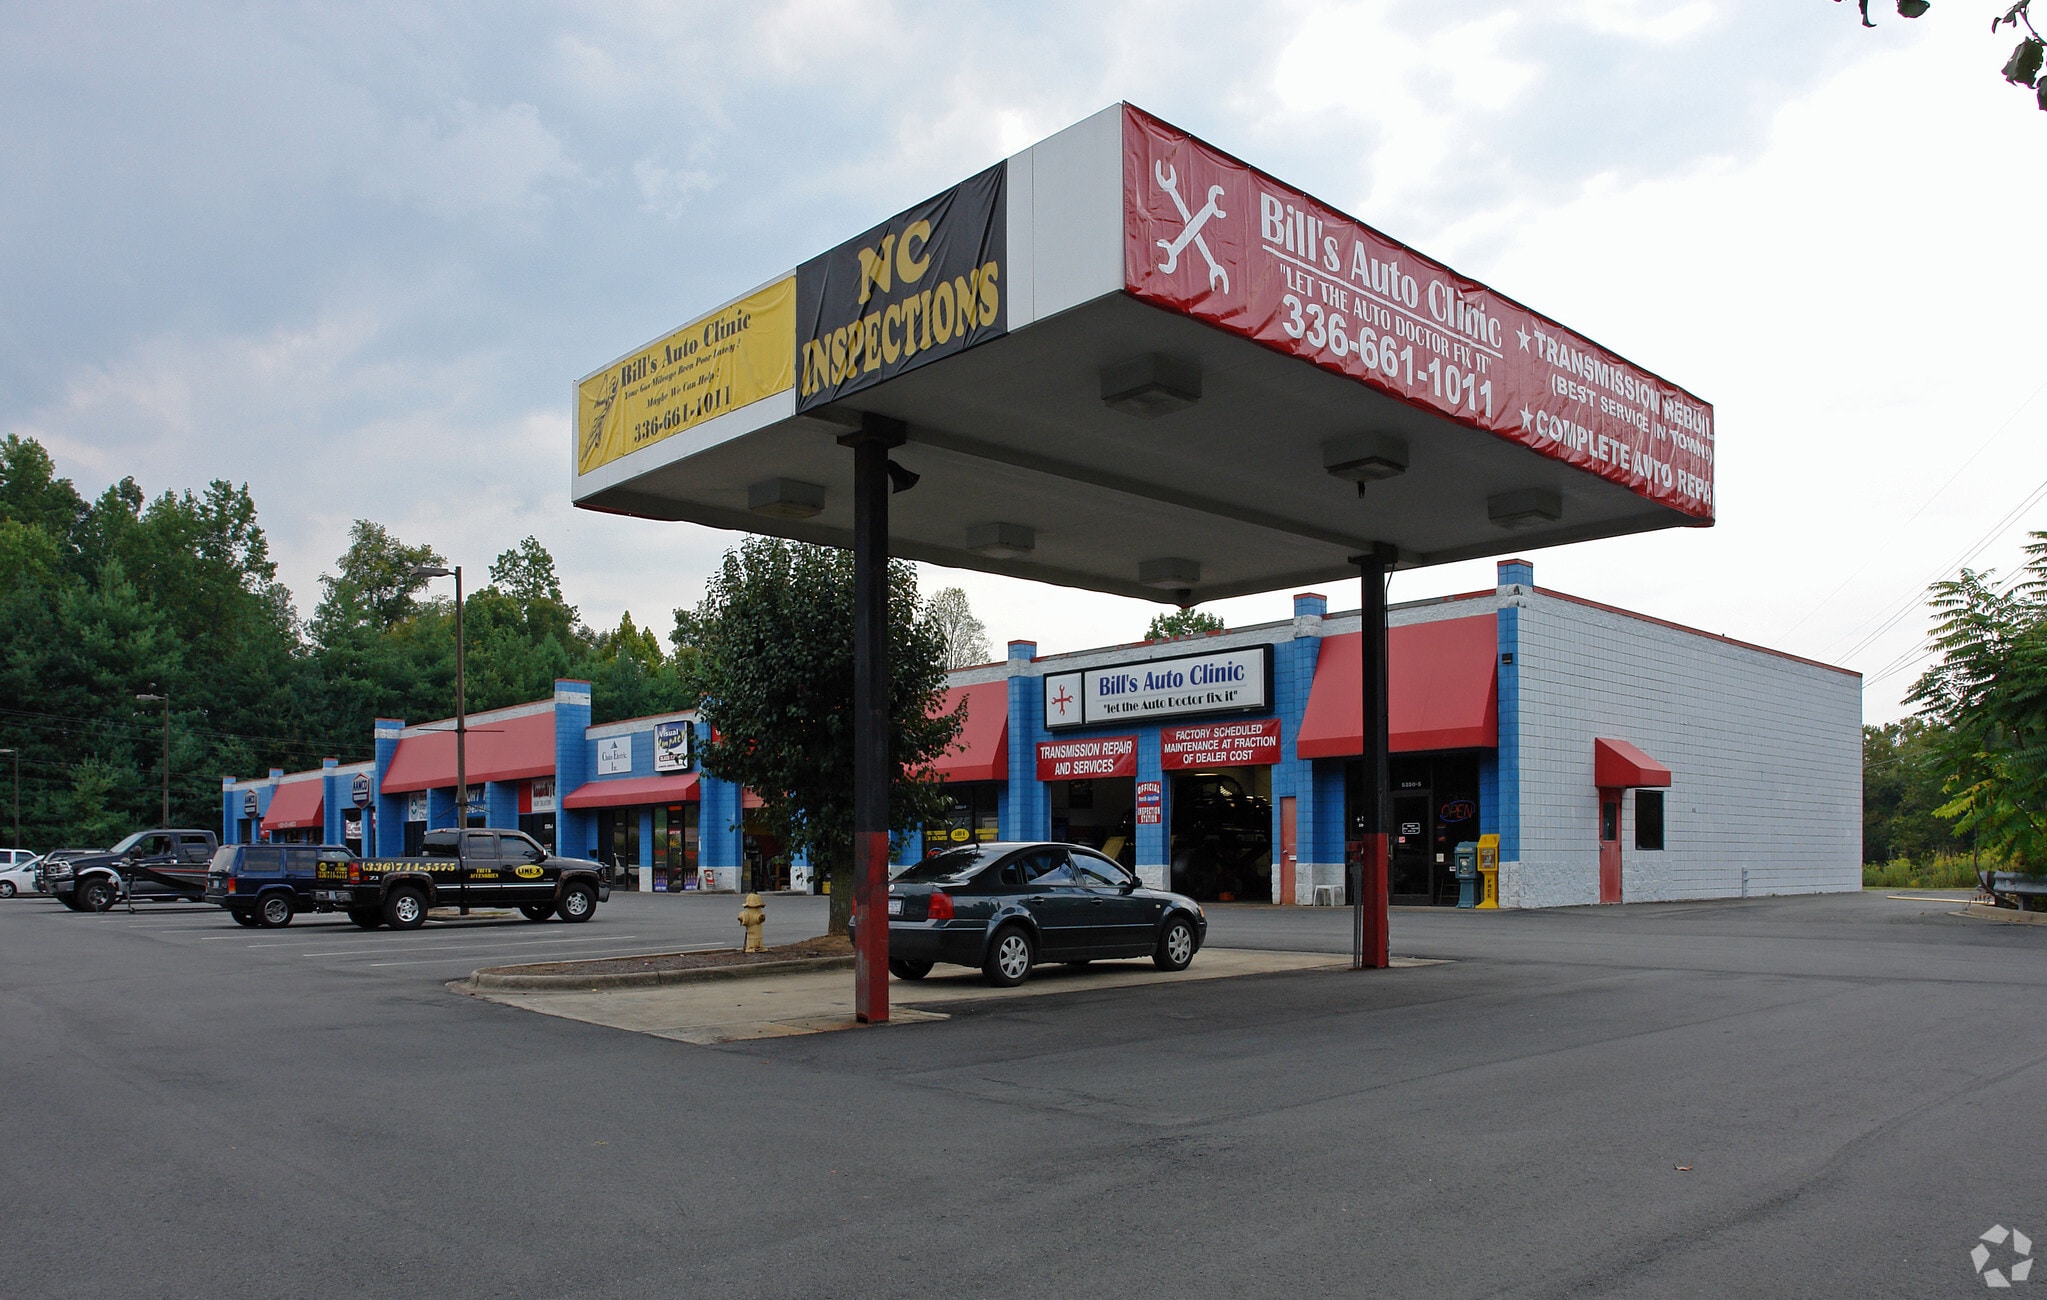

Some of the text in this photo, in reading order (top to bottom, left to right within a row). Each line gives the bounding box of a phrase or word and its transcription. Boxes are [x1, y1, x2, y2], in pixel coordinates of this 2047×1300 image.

[858, 219, 931, 305] NC
[1261, 192, 1502, 349] Bill's Auto Clinic
[801, 260, 999, 397] INSPECTIONS
[1280, 263, 1314, 297] "LET
[1319, 280, 1349, 313] THE
[1354, 297, 1391, 331] AUTO
[1396, 315, 1450, 358] DOCTOR
[1454, 344, 1472, 369] FIX
[621, 309, 751, 387] Bill's Auto Clinic
[1282, 294, 1492, 418] 336-661-1011
[624, 389, 638, 400] Your
[652, 370, 677, 386] Mileage
[678, 362, 694, 375] Been
[695, 354, 712, 366] Poor
[1534, 329, 1660, 415] TRANSMISSION
[634, 385, 731, 443] 336-661-1011
[646, 392, 668, 408] Maybe
[671, 386, 681, 397] We
[683, 380, 696, 392] Can
[1552, 373, 1712, 466] (BEST SERVICE IN TOWN!)
[1536, 409, 1630, 470] COMPLETE
[1633, 451, 1672, 488] AUTO
[1099, 661, 1245, 696] Bill's Auto Clinic
[1103, 703, 1121, 714] "let
[1122, 701, 1139, 711] the
[1140, 698, 1166, 710] Auto
[1168, 694, 1204, 708] Doctor
[1206, 692, 1222, 704] fix
[658, 728, 679, 737] Visual
[1040, 740, 1133, 760] TRANSMISSION REPAIR
[1164, 736, 1277, 753] MAINTENANCE AT FRACTION
[1175, 724, 1263, 741] FACTORY SCHEDULED
[1055, 759, 1114, 776] AND SERVICES
[1183, 750, 1253, 764] OF DEALER COST
[1137, 782, 1160, 795] OFFICIAL
[1441, 803, 1473, 819] OPEN
